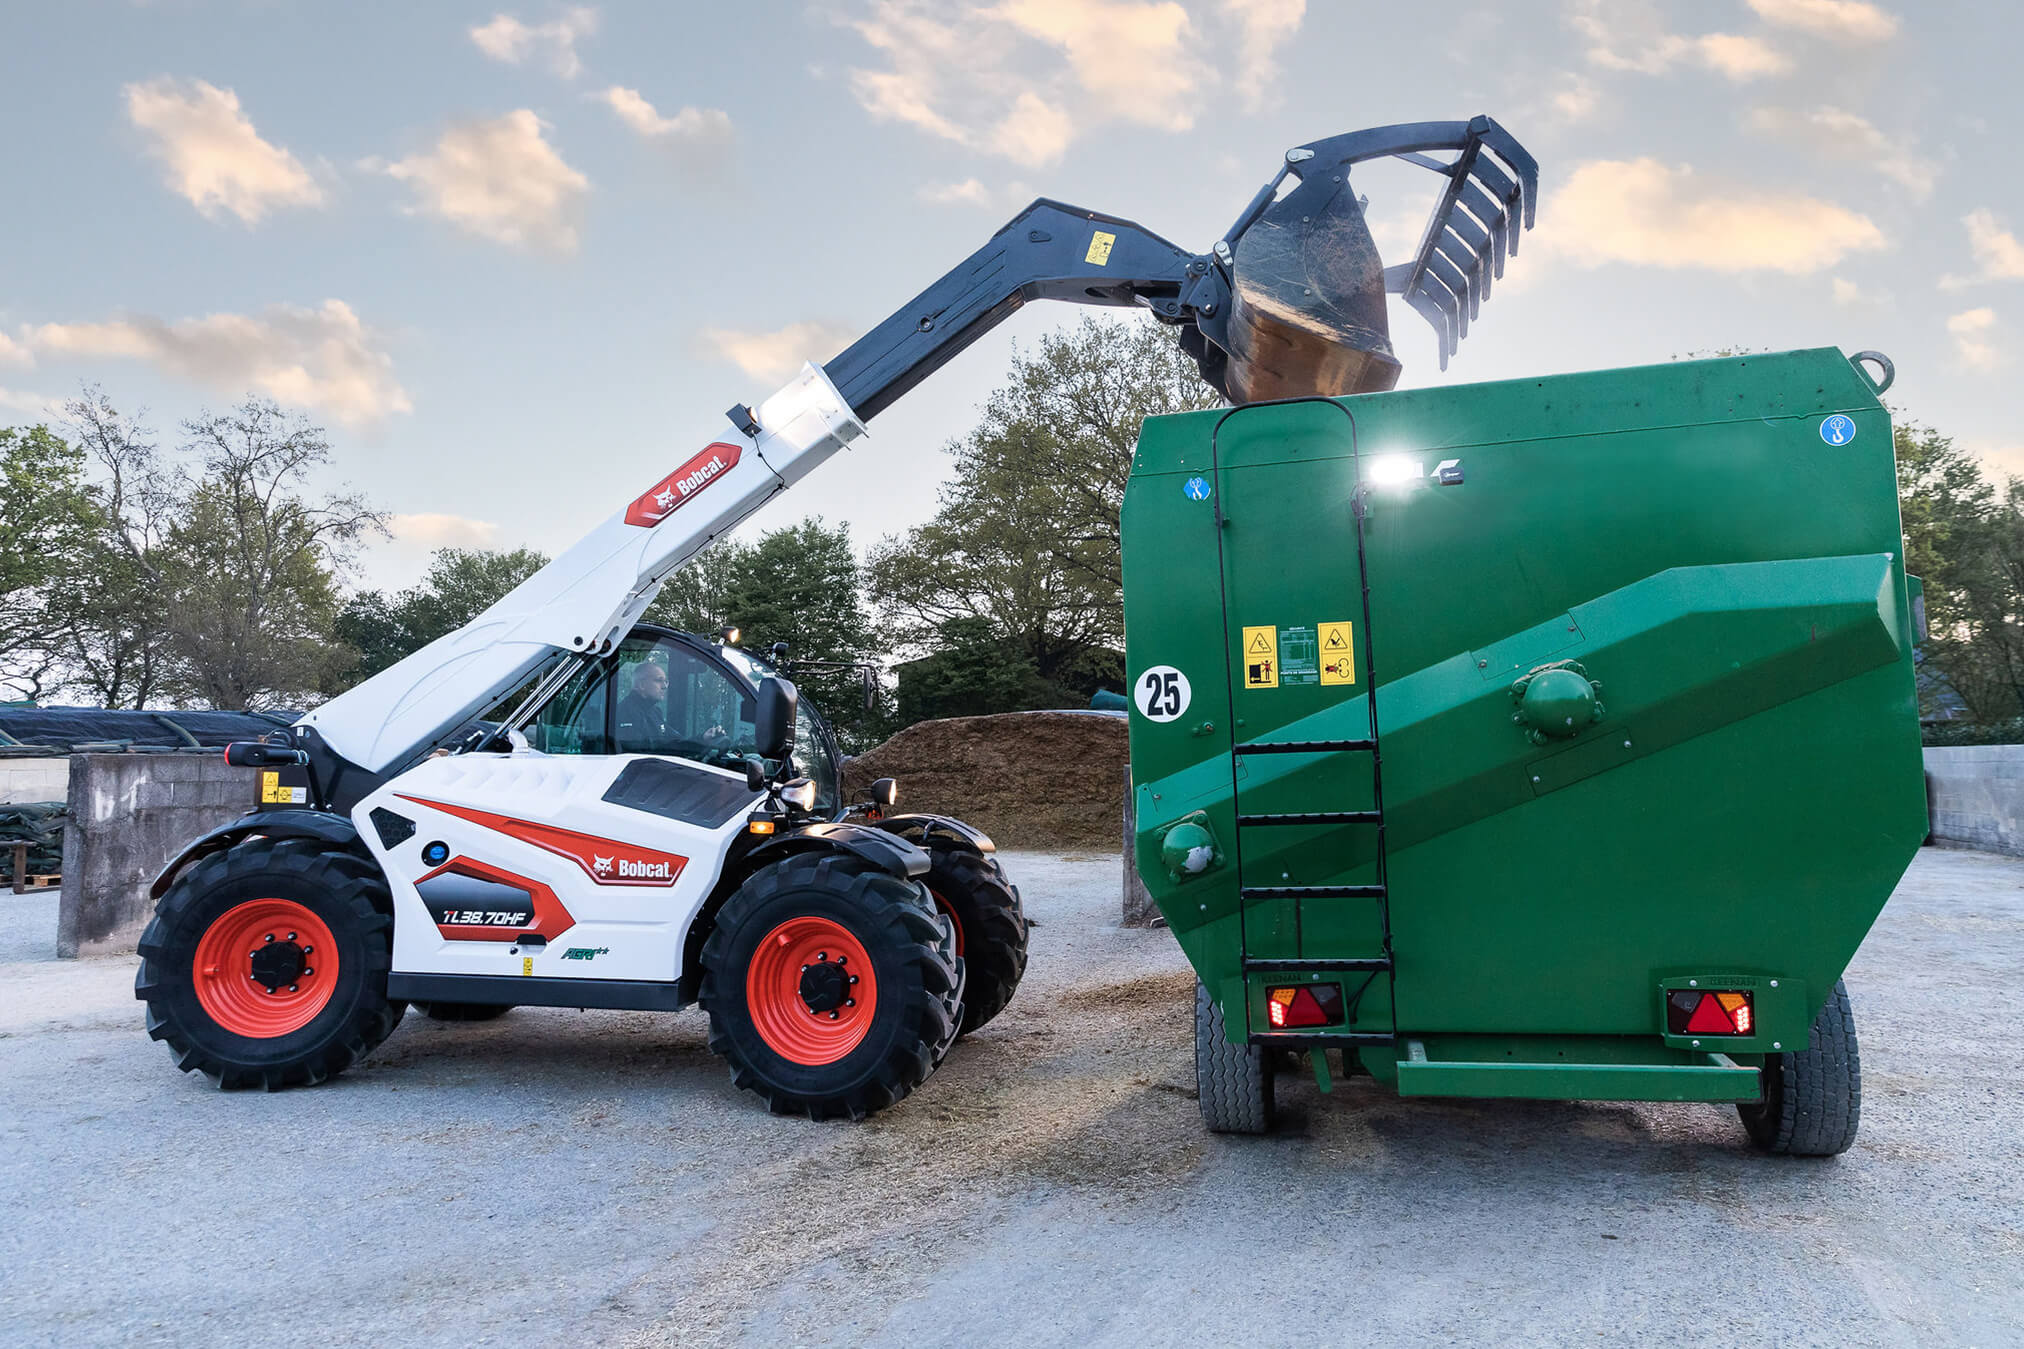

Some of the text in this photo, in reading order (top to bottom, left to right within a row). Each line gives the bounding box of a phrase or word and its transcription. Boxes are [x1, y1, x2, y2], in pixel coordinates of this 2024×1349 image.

[676, 455, 725, 496] Bobcat
[1146, 672, 1181, 717] 25
[618, 859, 670, 878] Bobcat
[443, 910, 526, 925] TL38.70HF
